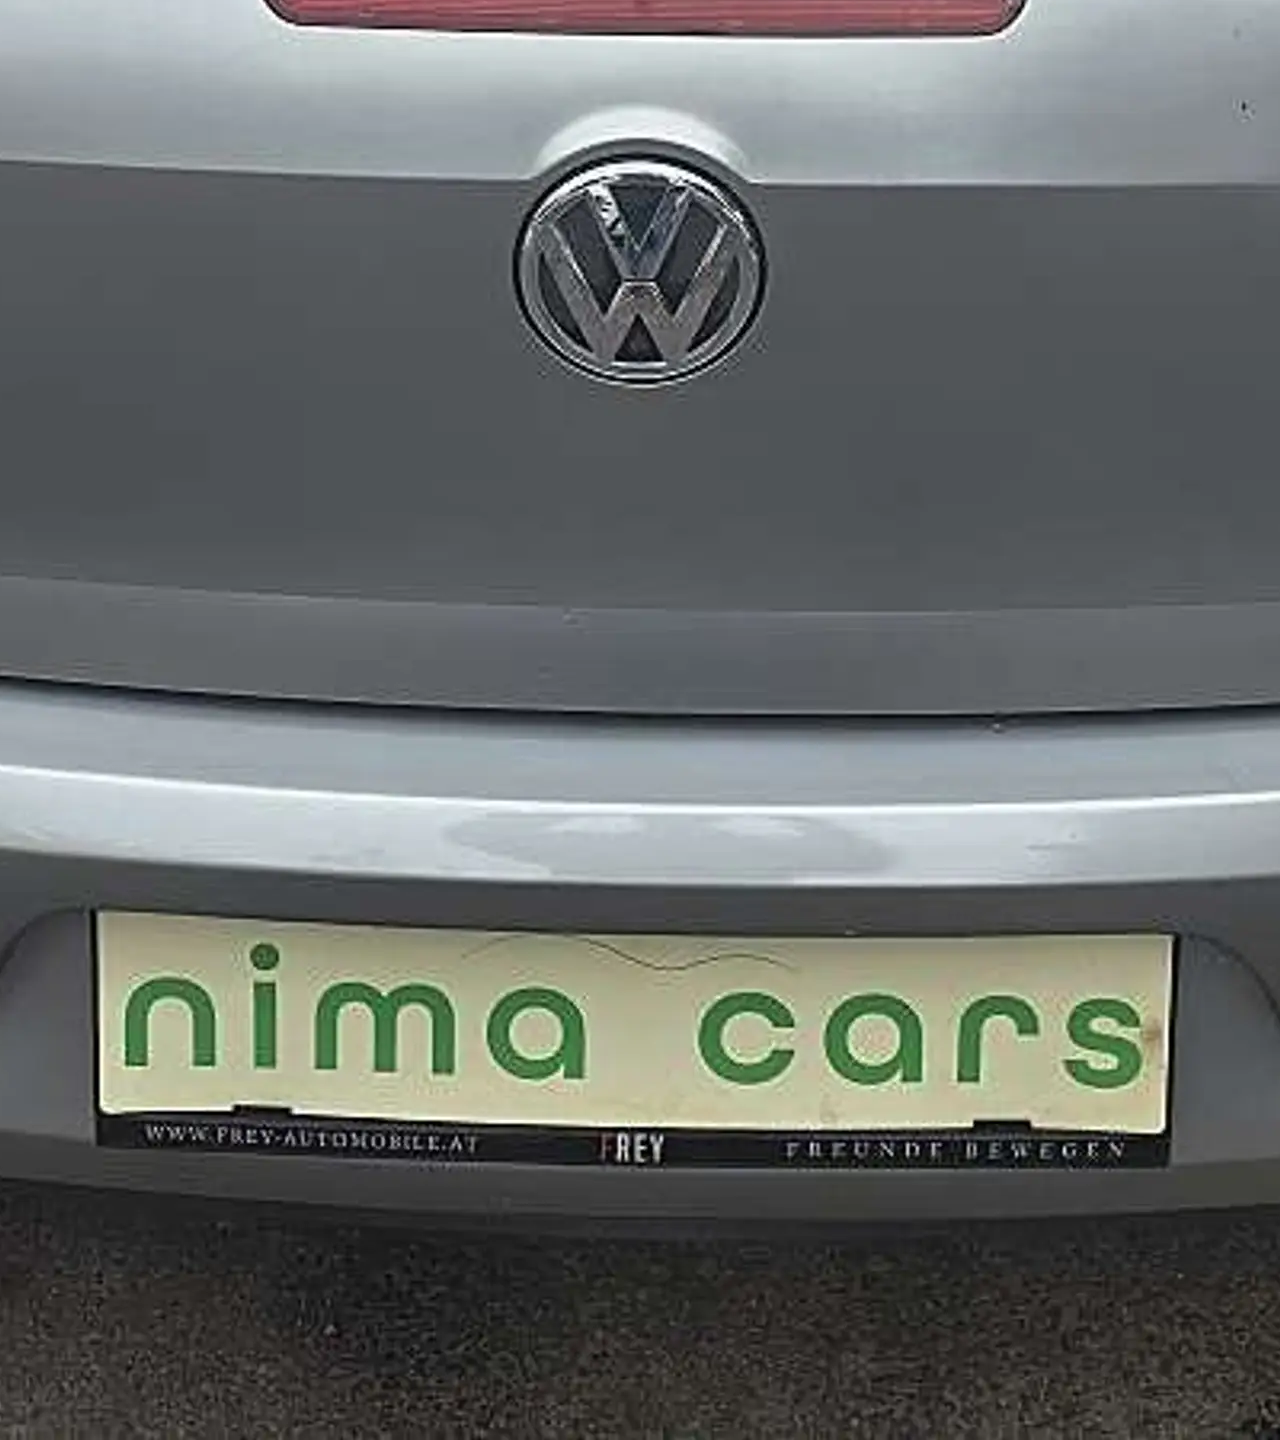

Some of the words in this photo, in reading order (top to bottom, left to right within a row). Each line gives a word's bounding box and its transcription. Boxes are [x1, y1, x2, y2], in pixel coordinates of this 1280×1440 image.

[122, 942, 587, 1080] nima
[698, 990, 1145, 1089] cars
[144, 1123, 480, 1154] WWW.FREY-AUTOMOBILE.AT
[600, 1132, 666, 1164] FREY
[785, 1140, 943, 1159] FREUNDE
[967, 1140, 1126, 1160] BEWEGEN
